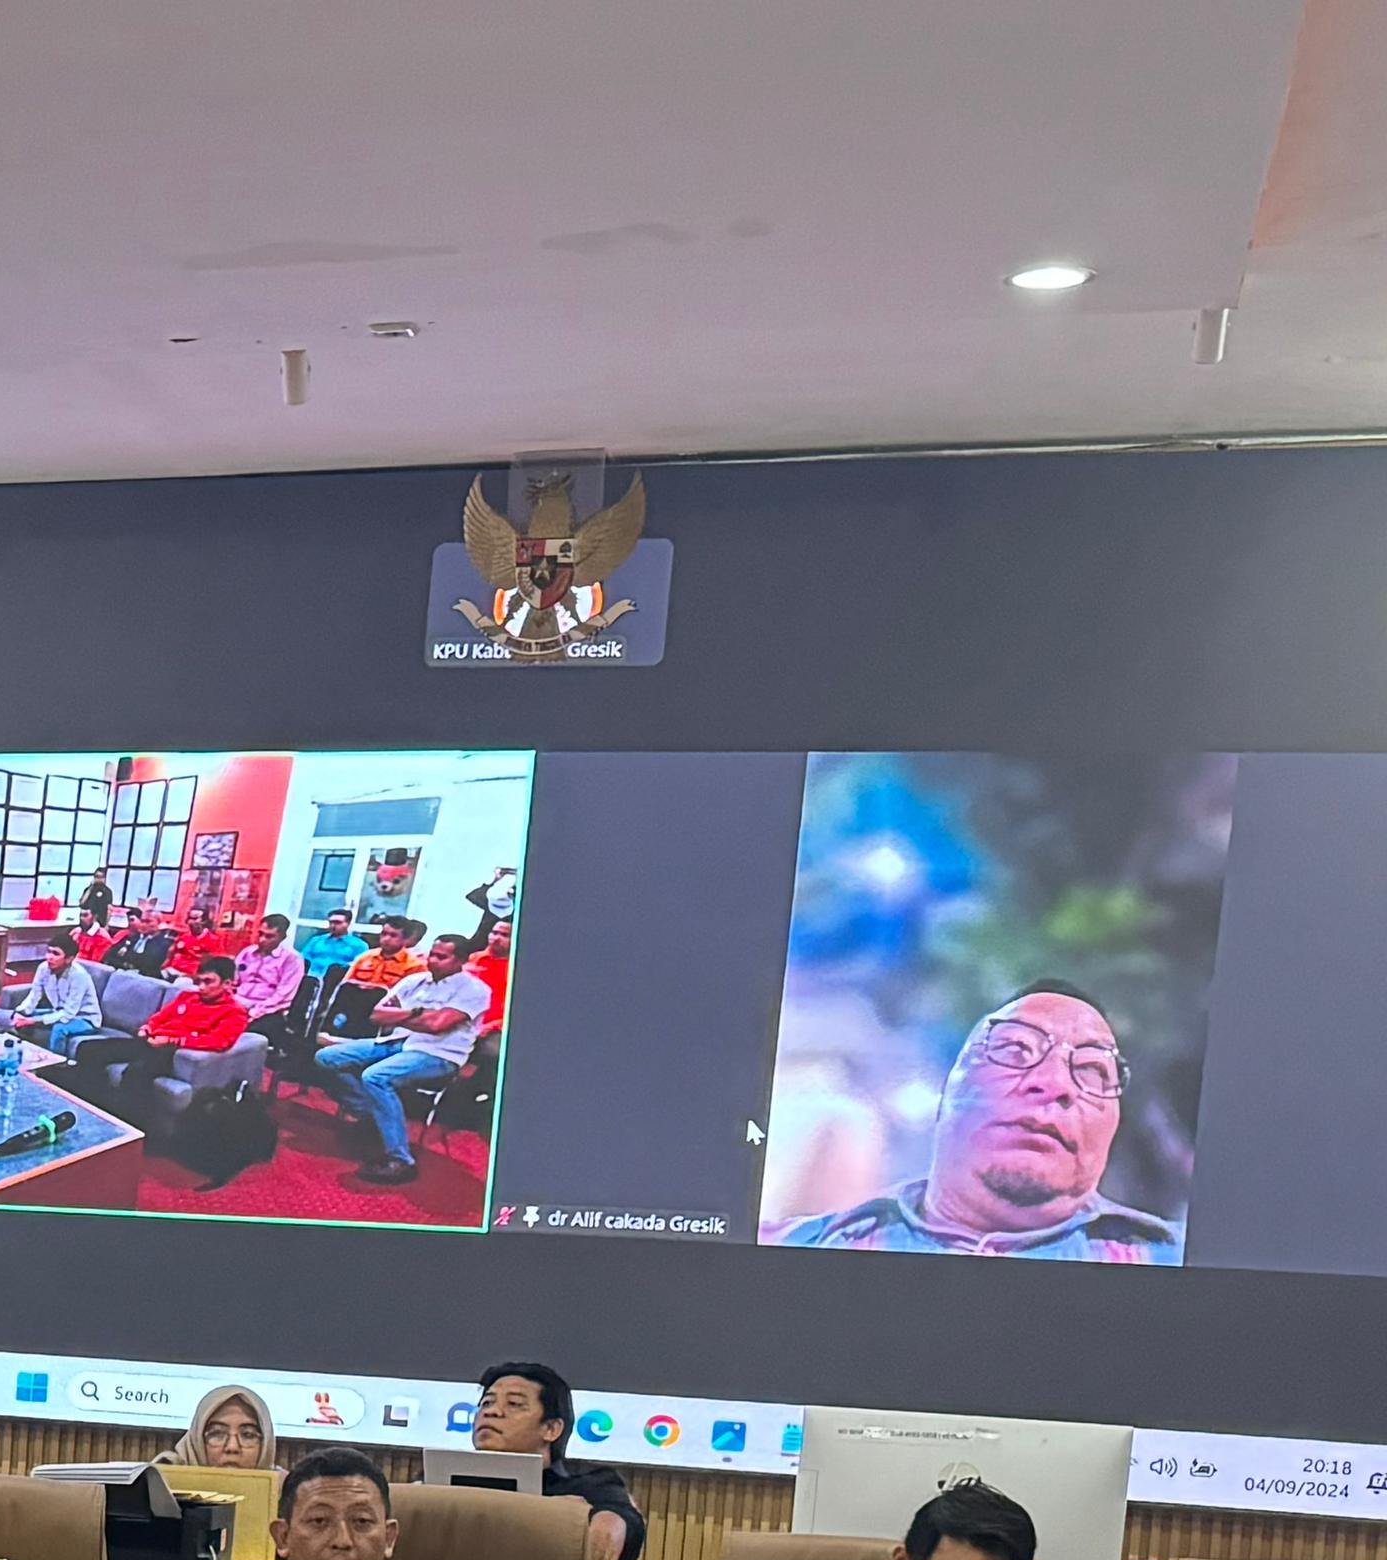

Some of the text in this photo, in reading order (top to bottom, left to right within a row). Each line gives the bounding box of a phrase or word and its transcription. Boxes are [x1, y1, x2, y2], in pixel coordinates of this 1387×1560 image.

[432, 643, 468, 659] KPU
[567, 641, 623, 659] Gresik
[547, 1210, 726, 1235] dr Alif cakada Gresik
[114, 1386, 169, 1404] Search
[1302, 1458, 1352, 1475] 20:18
[1244, 1477, 1350, 1498] 04/09/2024
